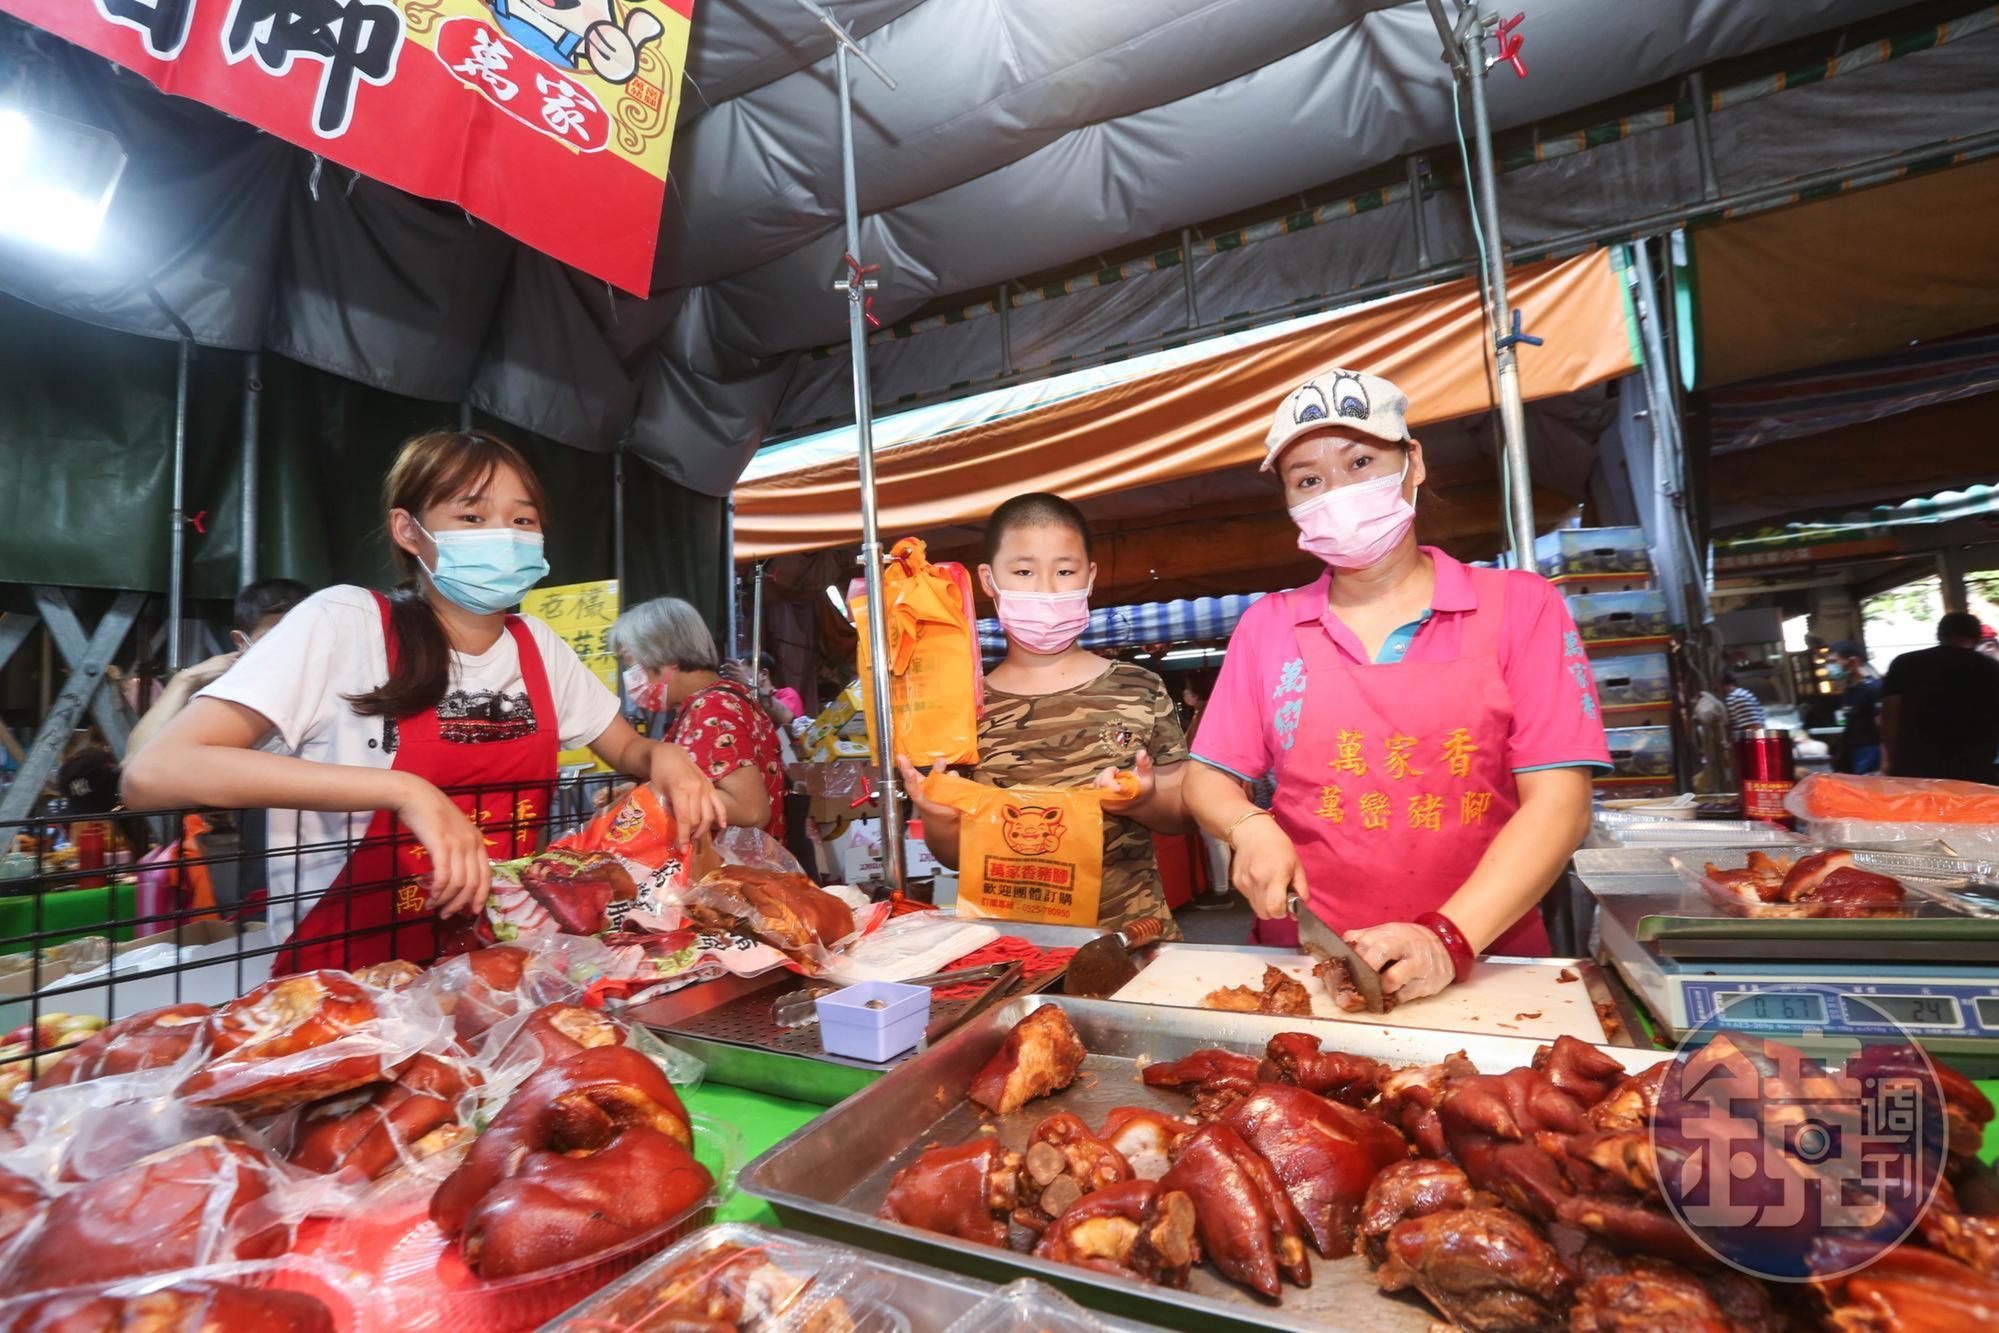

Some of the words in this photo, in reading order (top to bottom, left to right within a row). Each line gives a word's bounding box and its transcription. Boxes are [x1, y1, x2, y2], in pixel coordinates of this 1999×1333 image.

[1328, 728, 1479, 780] 萬家香
[1315, 785, 1493, 831] 萬巒豬腳
[983, 882, 1073, 906] 歡迎團體訂購
[1912, 1000, 1942, 1022] 24
